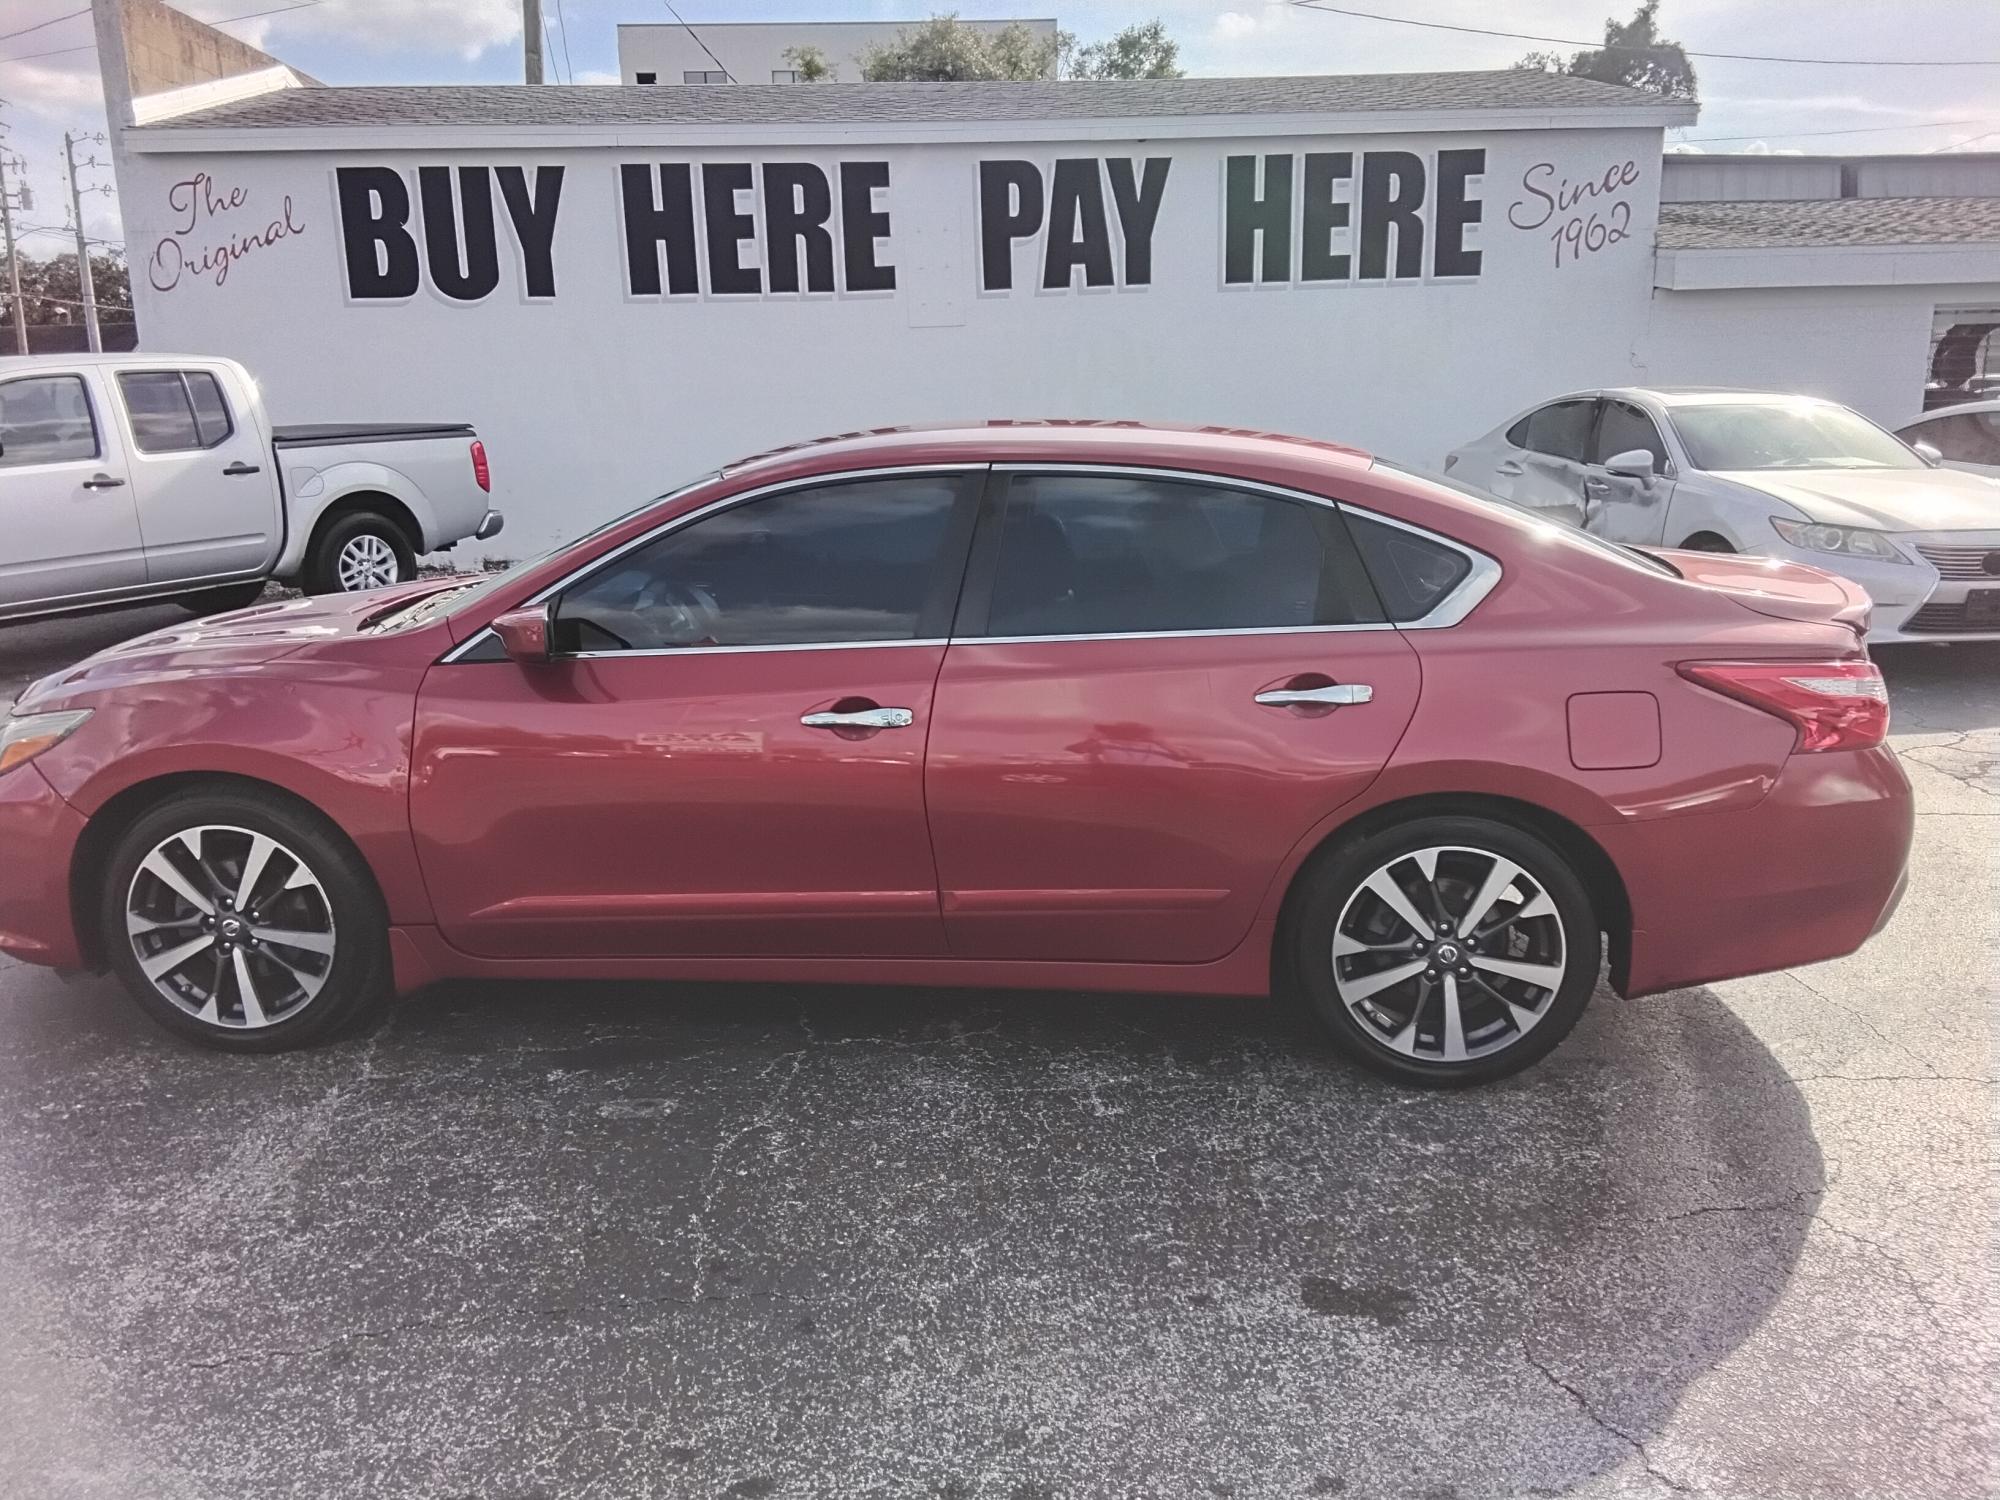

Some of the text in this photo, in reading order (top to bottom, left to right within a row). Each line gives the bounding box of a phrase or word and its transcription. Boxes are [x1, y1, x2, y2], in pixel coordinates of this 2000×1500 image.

[169, 172, 248, 235] The
[335, 148, 1487, 301] BUY HERE PAY HERE
[1508, 160, 1640, 230] Since
[149, 194, 306, 292] Original
[1550, 201, 1631, 268] 1962
